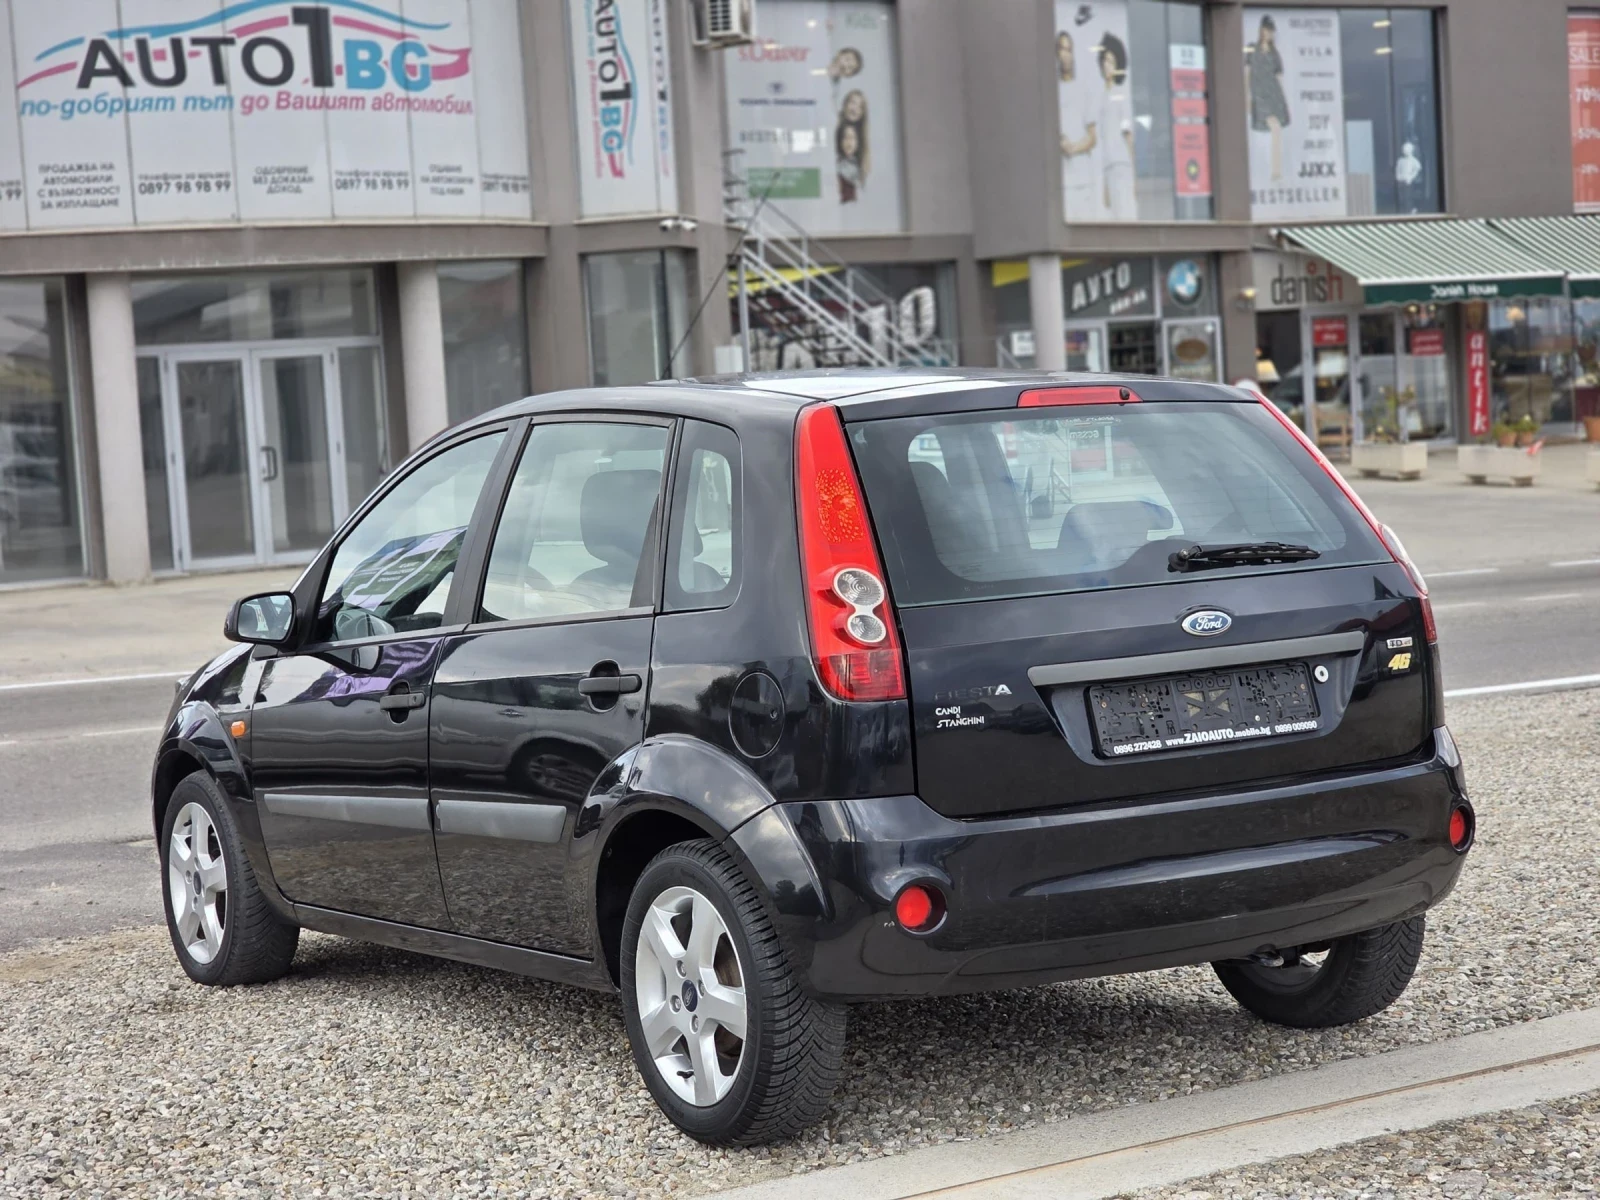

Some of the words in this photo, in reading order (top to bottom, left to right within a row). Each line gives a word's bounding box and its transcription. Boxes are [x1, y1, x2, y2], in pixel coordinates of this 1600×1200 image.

[183, 95, 235, 112] път
[275, 91, 366, 111] Вашият
[371, 92, 473, 115] автомобил
[1271, 263, 1343, 305] danish
[1196, 615, 1223, 630] Ford
[1388, 652, 1412, 670] 46
[935, 705, 961, 716] CANDI
[936, 716, 985, 729] STANGHINI
[1113, 743, 1134, 754] 0896
[1133, 739, 1162, 752] 272428
[1274, 723, 1292, 733] 0899
